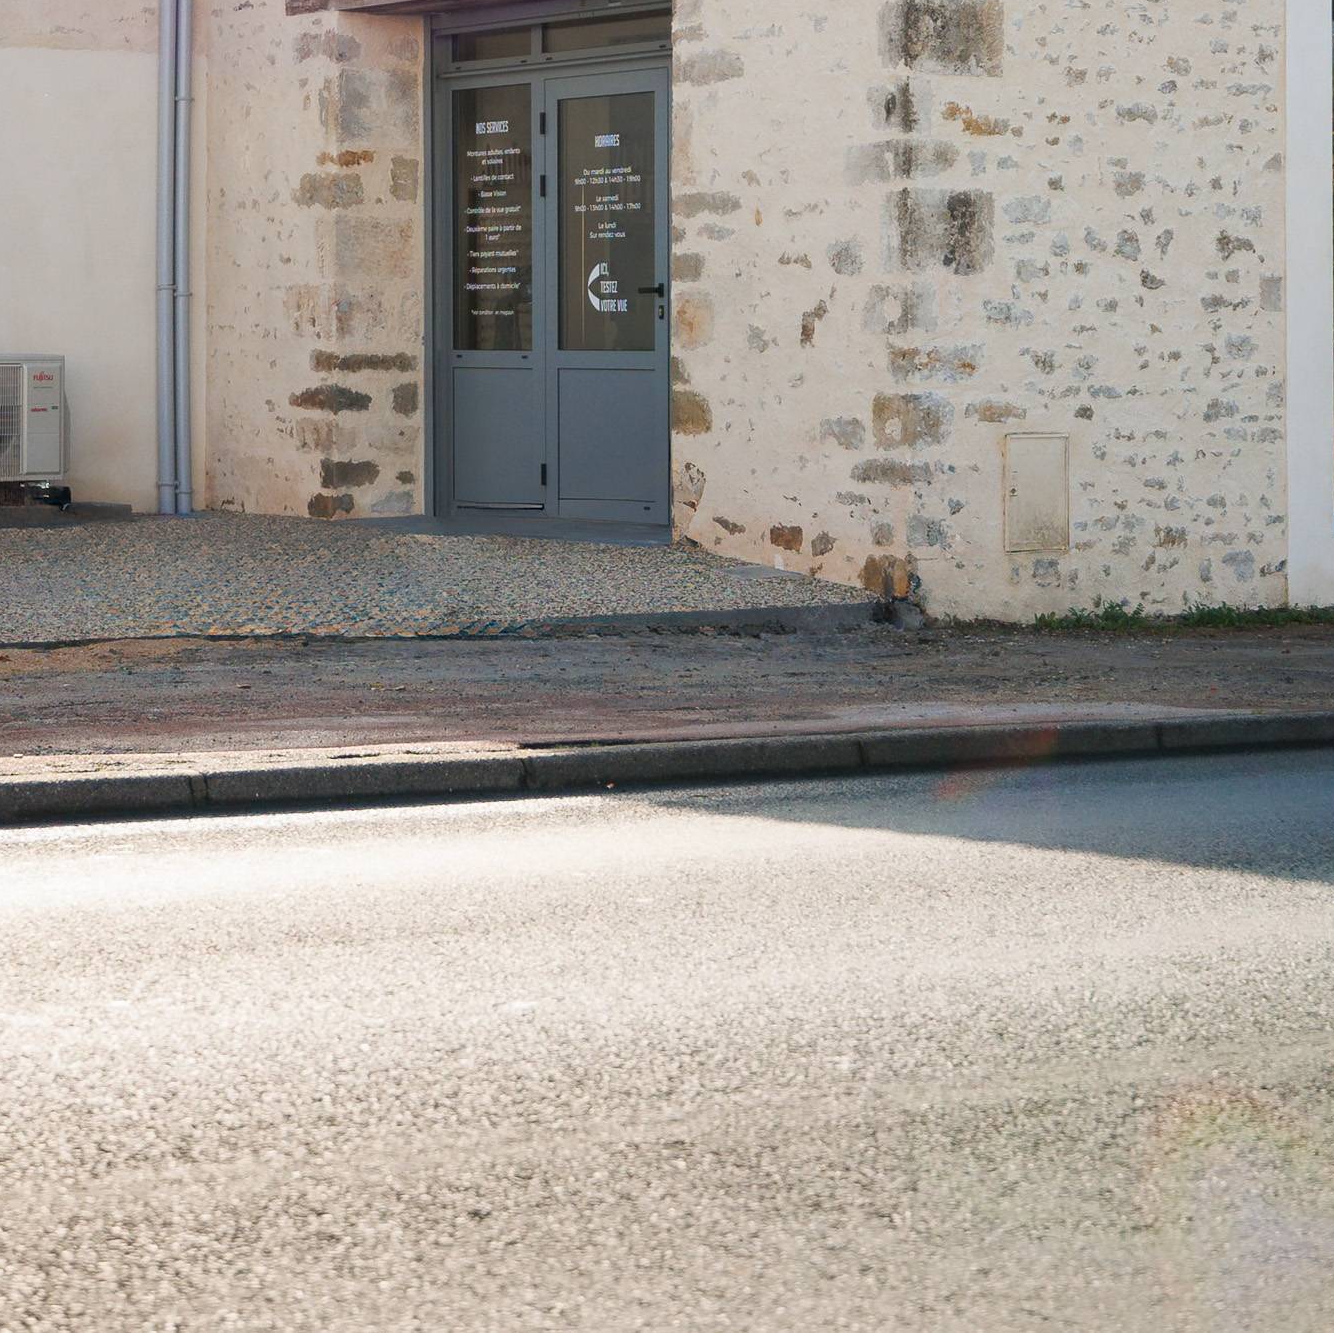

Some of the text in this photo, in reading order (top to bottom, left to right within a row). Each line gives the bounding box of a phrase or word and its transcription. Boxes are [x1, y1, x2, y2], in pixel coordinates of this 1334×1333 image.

[476, 120, 508, 134] NOS SERVICES
[594, 134, 620, 147] HORAIRES
[612, 166, 632, 174] vendredi
[602, 194, 619, 202] samedi
[589, 231, 597, 239] Sur
[600, 262, 609, 276] ICI,
[600, 280, 618, 293] TESTEZ
[600, 299, 627, 312] VOTRE VUE
